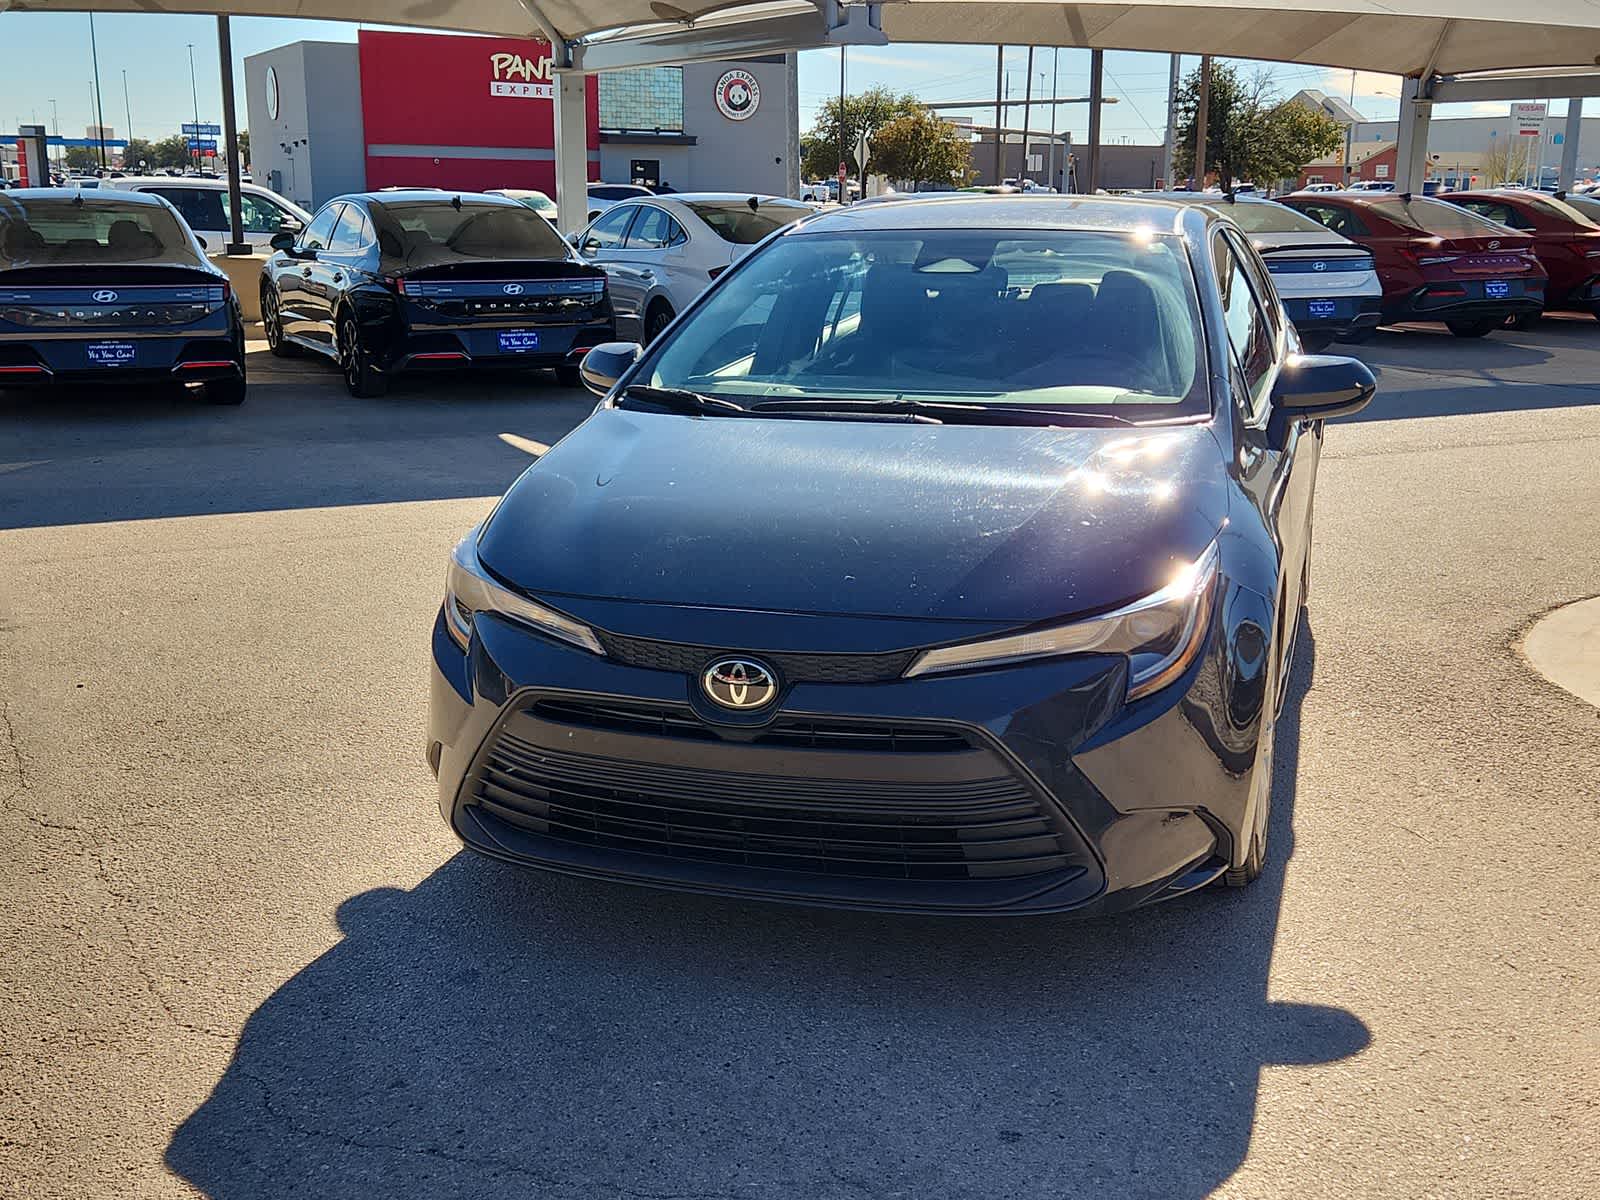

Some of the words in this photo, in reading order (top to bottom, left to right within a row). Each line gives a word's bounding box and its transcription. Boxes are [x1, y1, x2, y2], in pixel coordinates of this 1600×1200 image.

[718, 73, 734, 96] PANDA
[736, 71, 758, 97] EXPRESS
[101, 350, 115, 359] You
[116, 349, 135, 358] Can!
